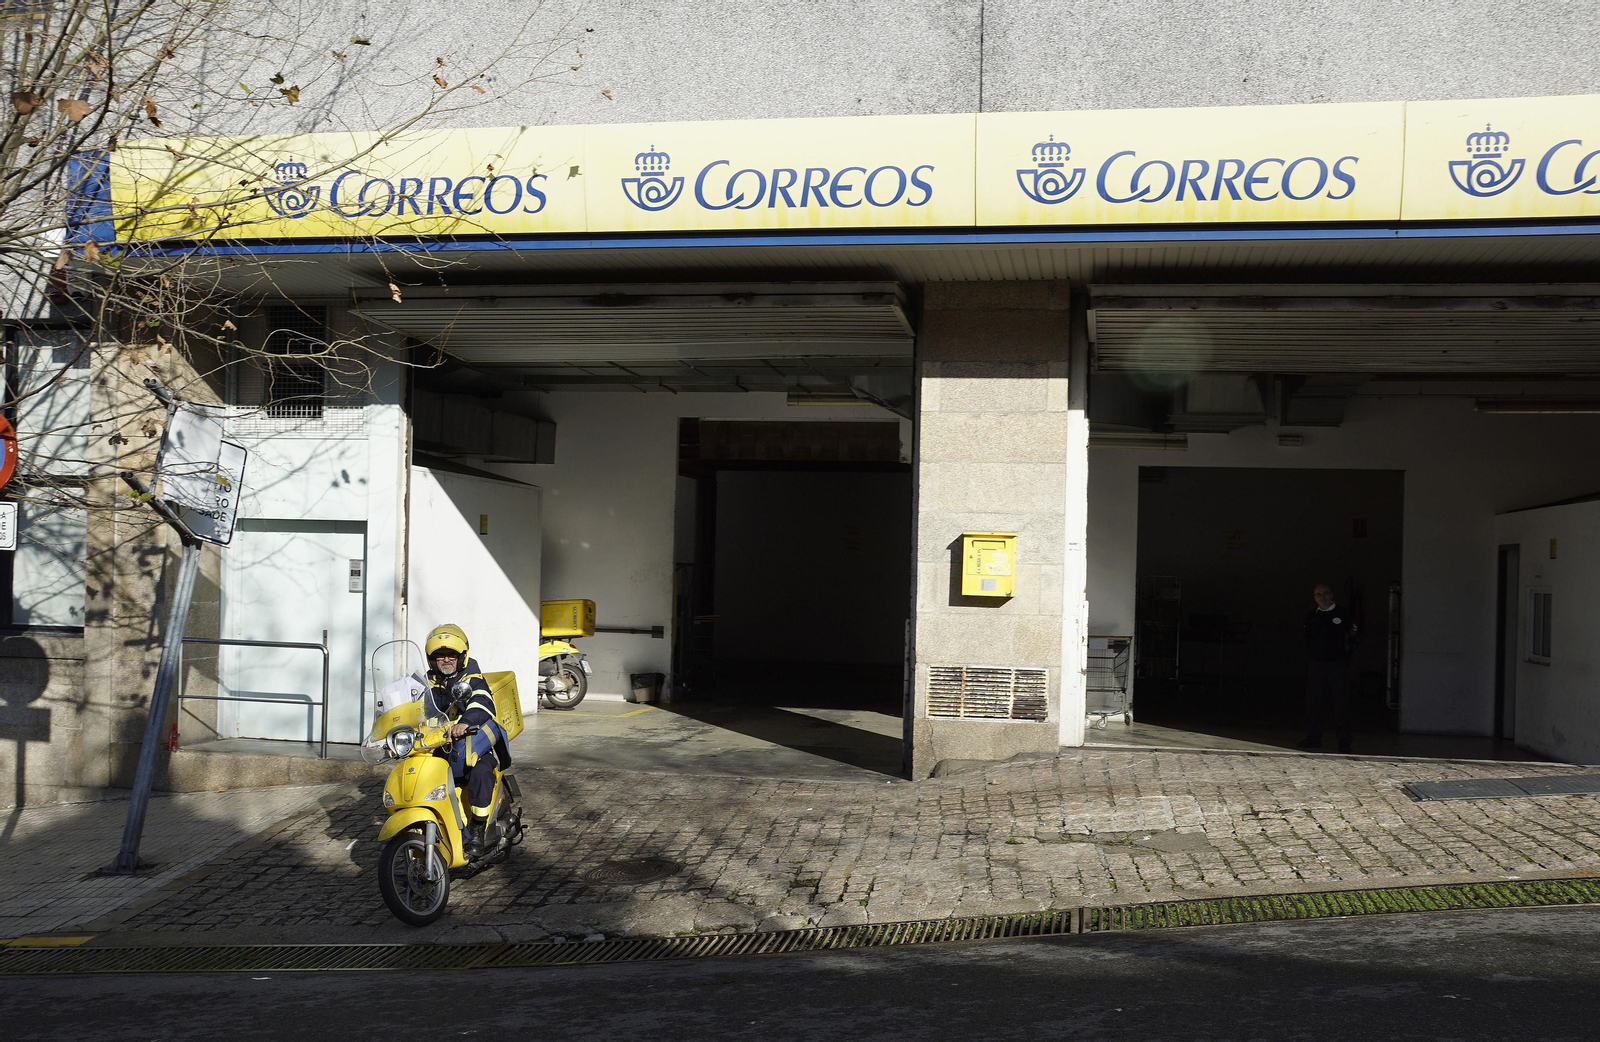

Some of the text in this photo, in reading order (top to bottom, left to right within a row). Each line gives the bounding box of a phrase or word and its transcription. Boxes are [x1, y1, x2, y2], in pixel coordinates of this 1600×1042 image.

[329, 170, 547, 218] CORREOS
[694, 160, 935, 211] CORREOS
[1096, 150, 1359, 204] CORREOS
